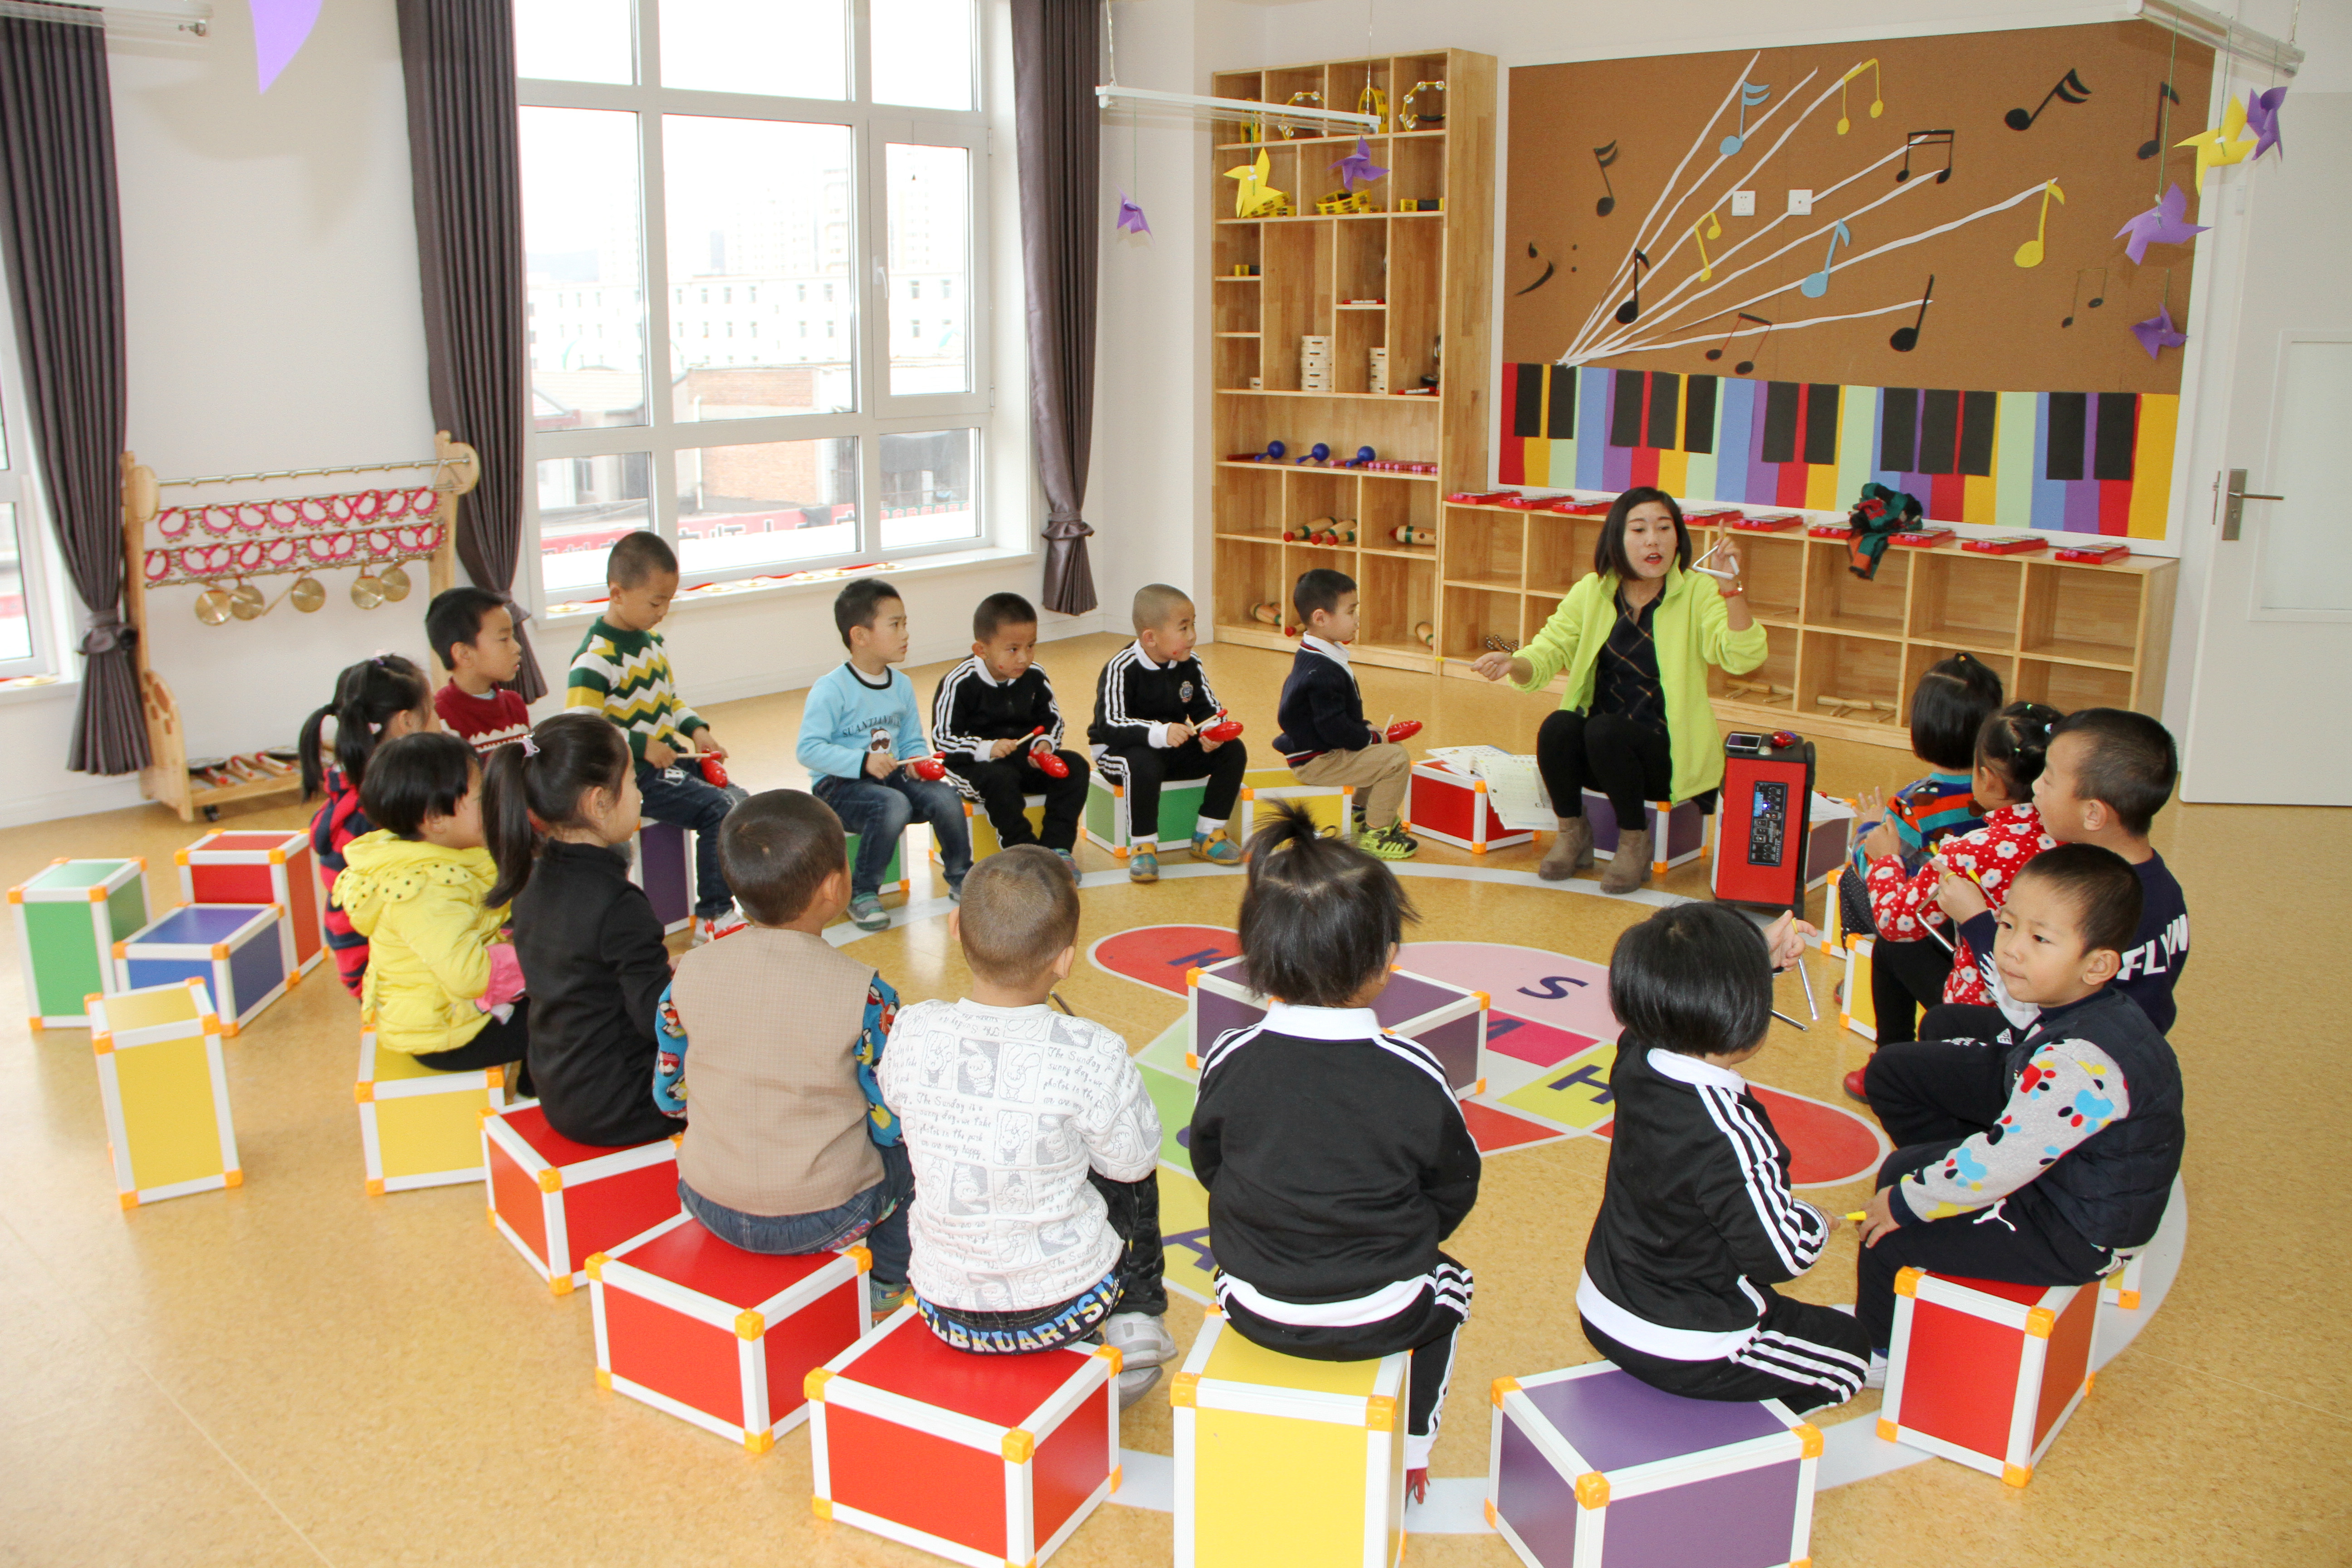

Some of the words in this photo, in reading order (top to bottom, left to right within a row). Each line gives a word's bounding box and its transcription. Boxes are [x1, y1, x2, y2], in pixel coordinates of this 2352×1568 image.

[1517, 976, 1589, 1000] S
[1048, 1046, 1064, 1058] The
[1068, 1051, 1101, 1073] Sunday
[916, 1092, 931, 1104] The
[934, 1096, 965, 1114] Sunday
[974, 1116, 991, 1128] take
